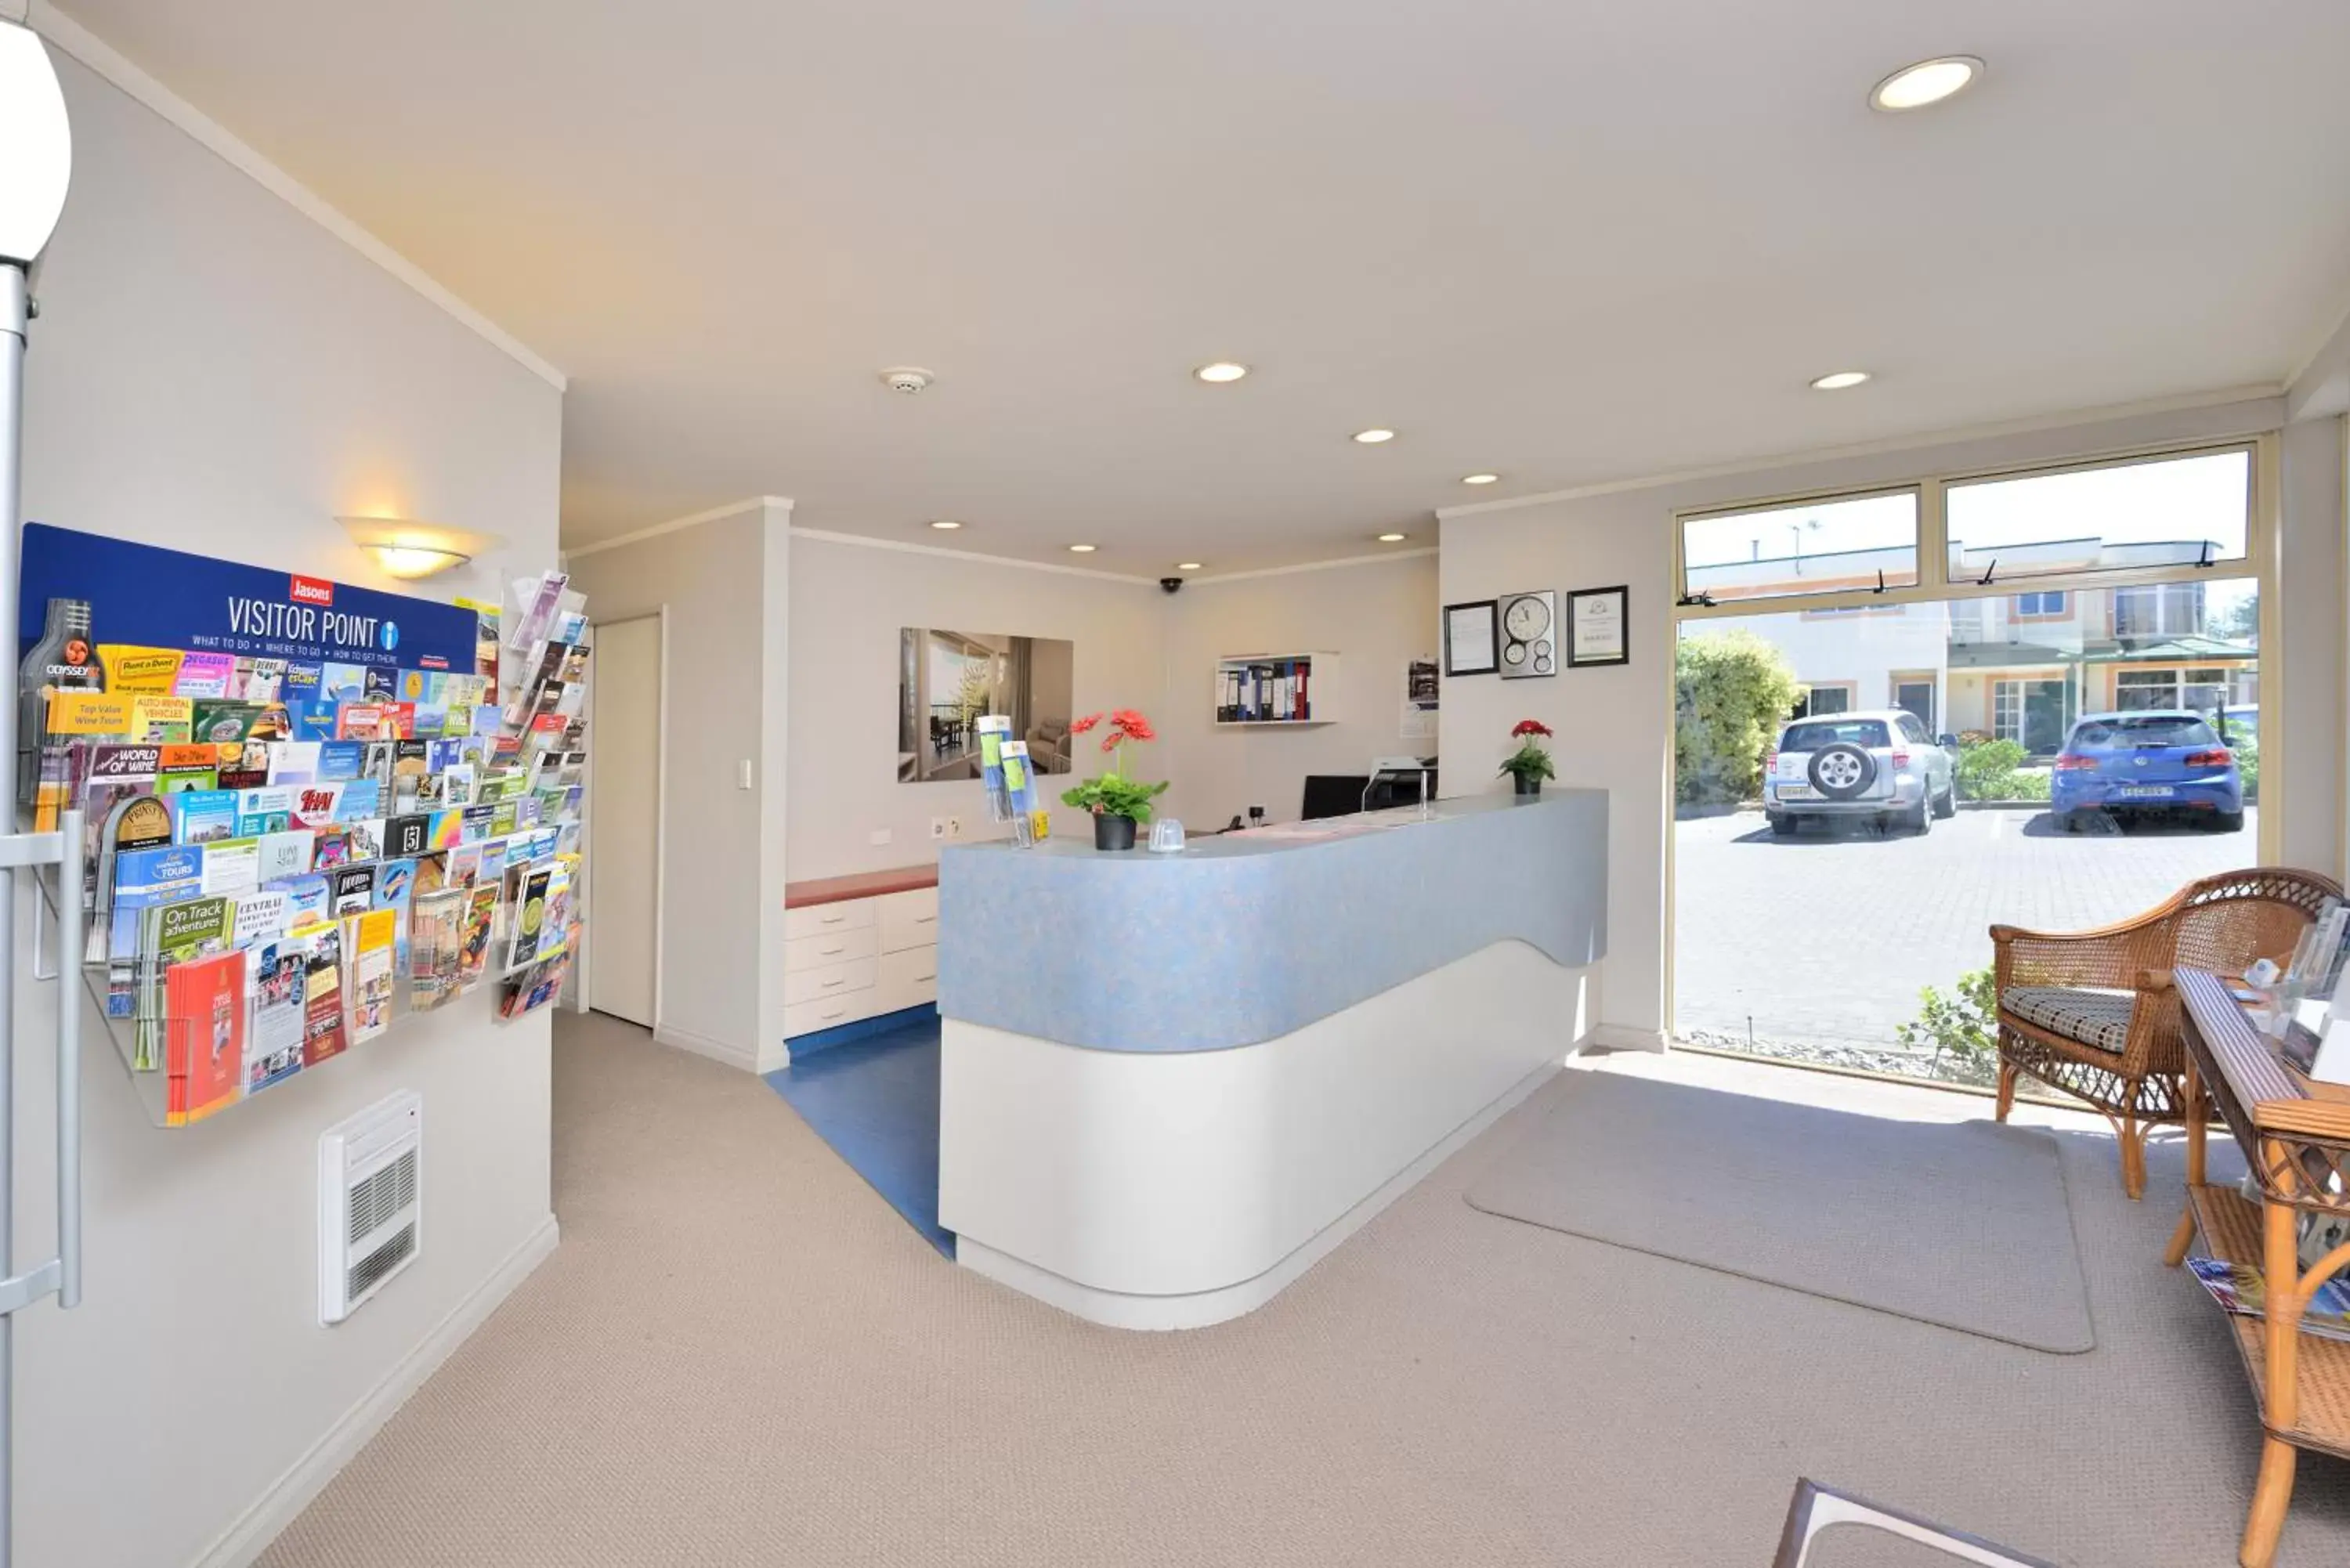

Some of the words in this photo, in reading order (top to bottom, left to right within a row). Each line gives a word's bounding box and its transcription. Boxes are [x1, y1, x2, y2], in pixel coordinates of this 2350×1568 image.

[294, 580, 330, 602] Jasons
[228, 596, 314, 641] VISITOR
[321, 610, 378, 648] POINT
[192, 634, 220, 647] WHAT
[223, 638, 234, 649] TO
[238, 639, 250, 650] DO
[266, 643, 295, 655] WHERE
[297, 646, 308, 656] TO
[309, 647, 320, 658] GO
[333, 650, 349, 659] HOW
[352, 652, 362, 661] TO
[363, 652, 375, 663] GET
[376, 654, 397, 664] THERE
[80, 704, 94, 714] Top
[99, 704, 121, 714] Value
[137, 698, 159, 707] AUTO
[161, 699, 190, 708] RENTAL
[75, 716, 97, 724] Wine
[144, 709, 183, 718] VEHICLES
[119, 750, 158, 761] WORLD
[110, 762, 125, 773] OF
[128, 761, 156, 772] WINE
[161, 864, 193, 878] TOURS
[166, 909, 186, 924] On
[190, 901, 222, 919] Track
[240, 898, 282, 914] CENTRAL
[165, 916, 220, 938] adventures
